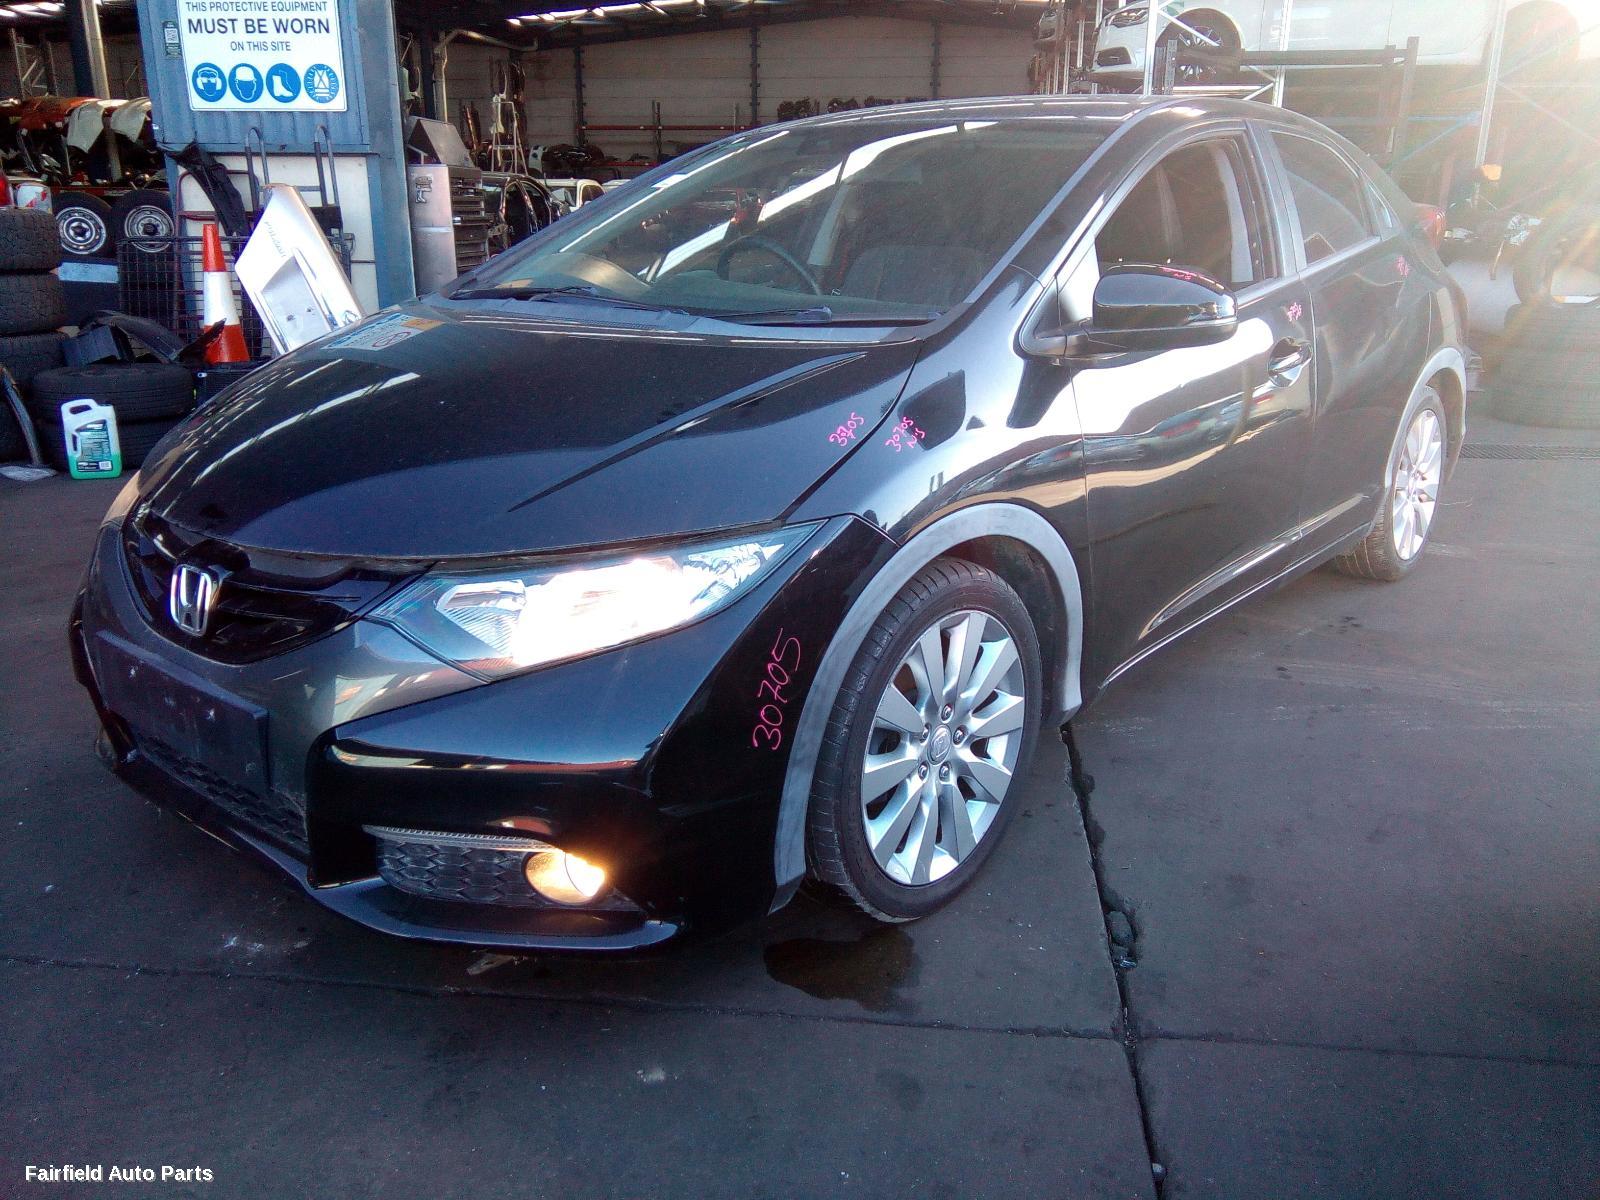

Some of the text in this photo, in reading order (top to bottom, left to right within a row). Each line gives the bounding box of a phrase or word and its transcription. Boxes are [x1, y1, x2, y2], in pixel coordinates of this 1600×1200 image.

[186, 1, 327, 12] THIS PROTECTIVE EQUIPMENT
[188, 18, 330, 34] MUST BE WORN
[230, 41, 291, 51] ON THIS SITE
[752, 627, 801, 751] 30705
